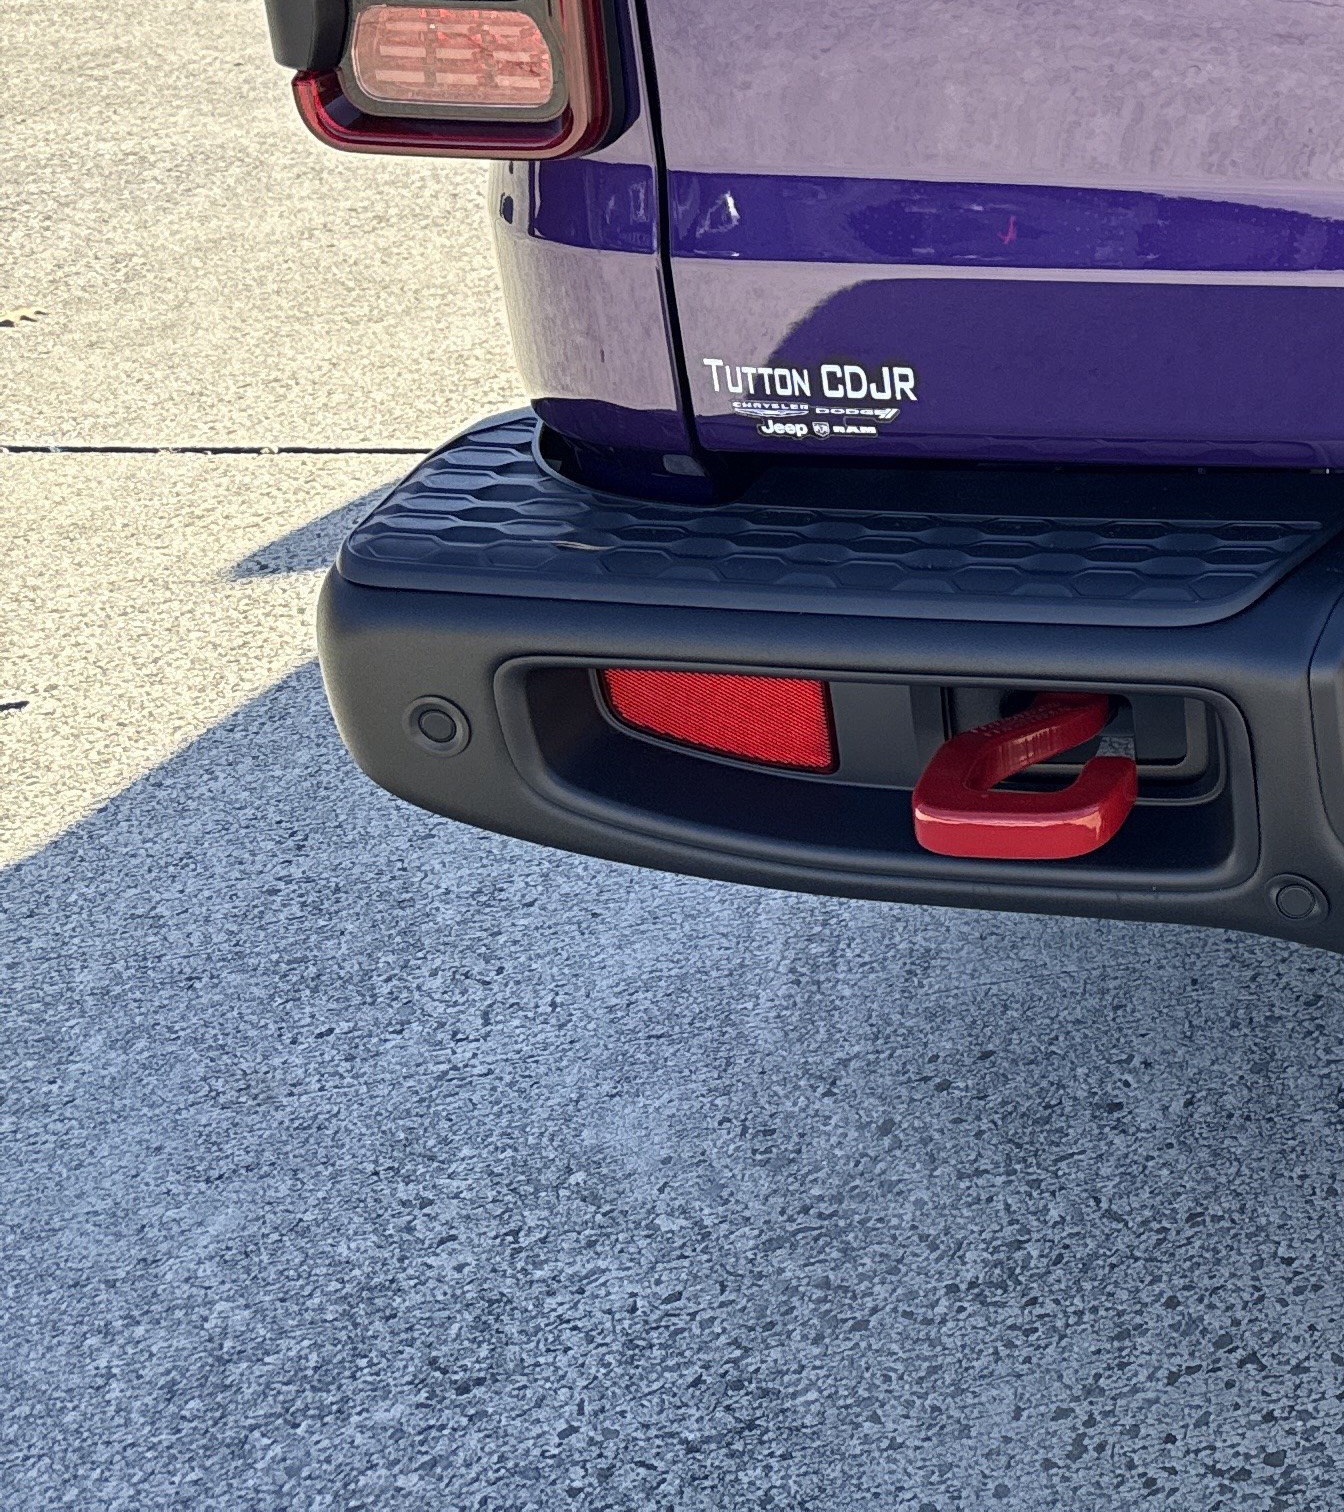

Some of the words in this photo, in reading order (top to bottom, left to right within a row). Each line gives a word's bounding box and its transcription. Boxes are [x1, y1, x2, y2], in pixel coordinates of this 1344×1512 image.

[820, 364, 918, 401] CDJR
[760, 419, 808, 437] Jeep
[832, 425, 877, 434] RAM
